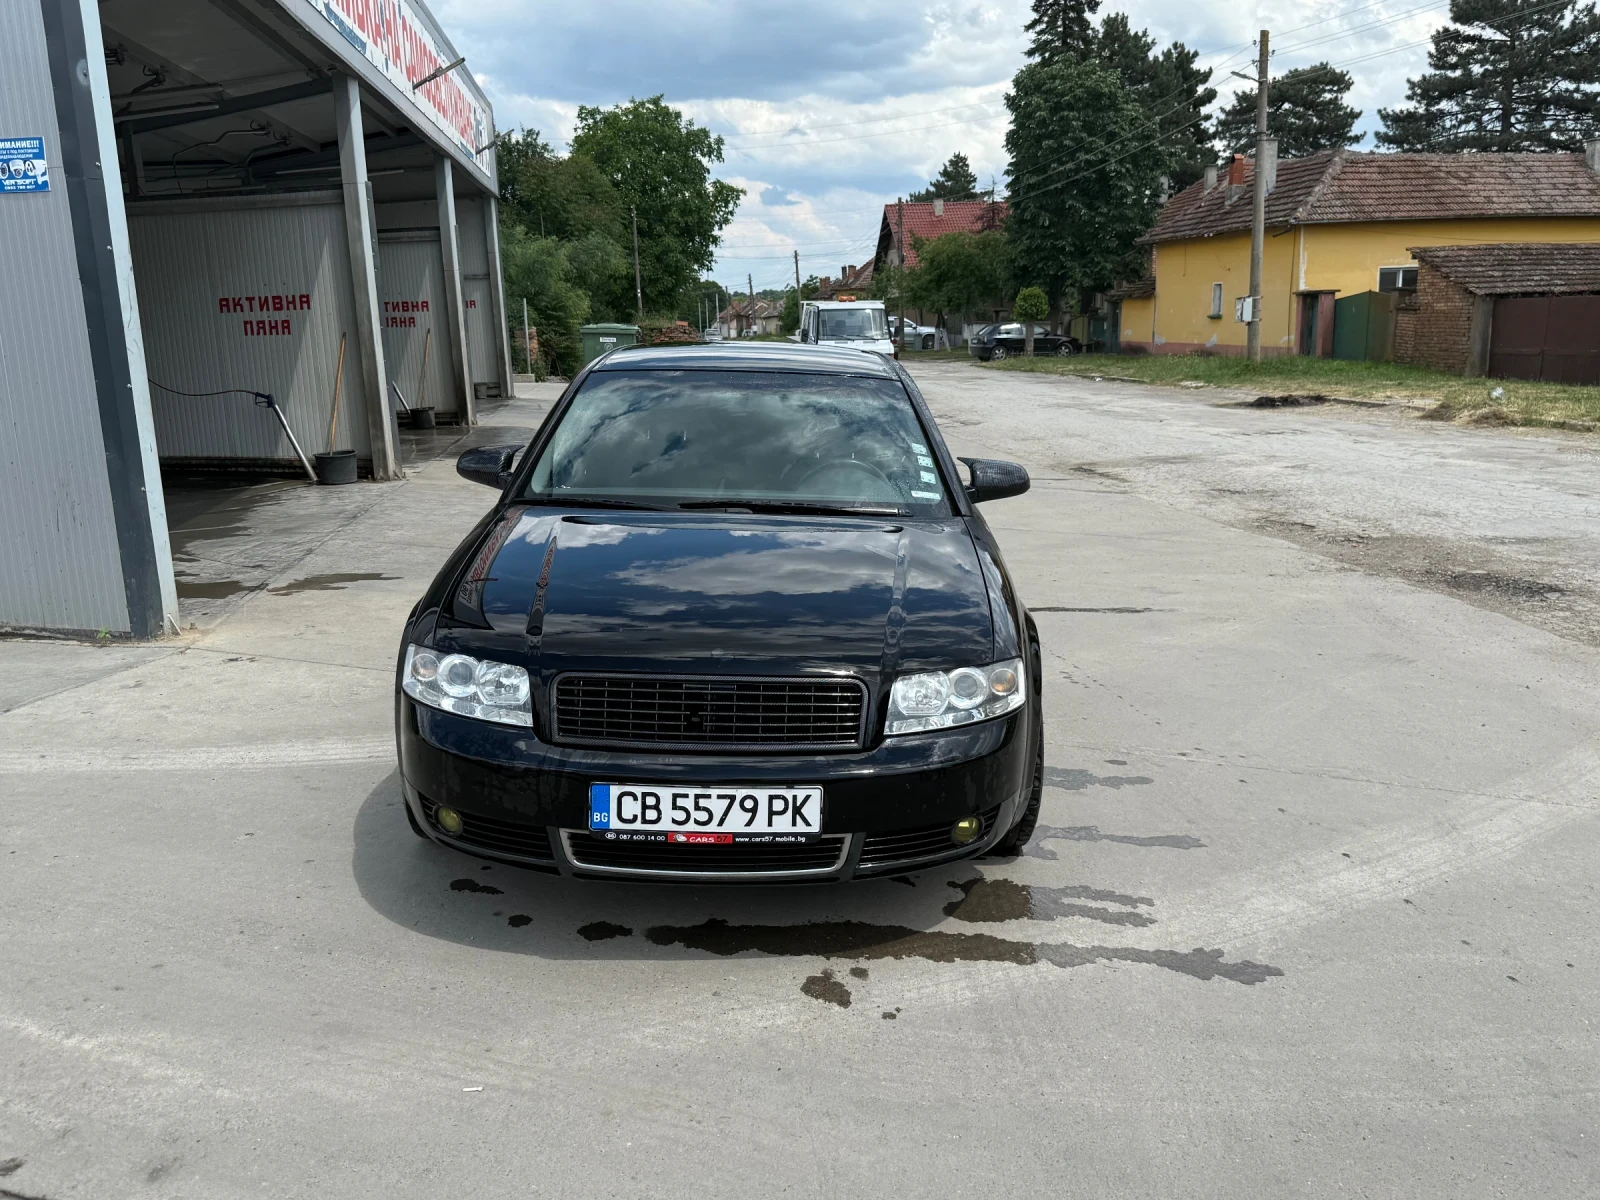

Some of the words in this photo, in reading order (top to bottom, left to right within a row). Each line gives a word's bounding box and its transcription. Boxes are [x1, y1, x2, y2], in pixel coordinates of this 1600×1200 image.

[218, 293, 311, 314] АКТИВНА
[243, 318, 291, 336] ПЯНА
[593, 812, 608, 822] BG
[616, 791, 662, 825] CB
[671, 792, 759, 827] 5579
[767, 794, 812, 828] PK
